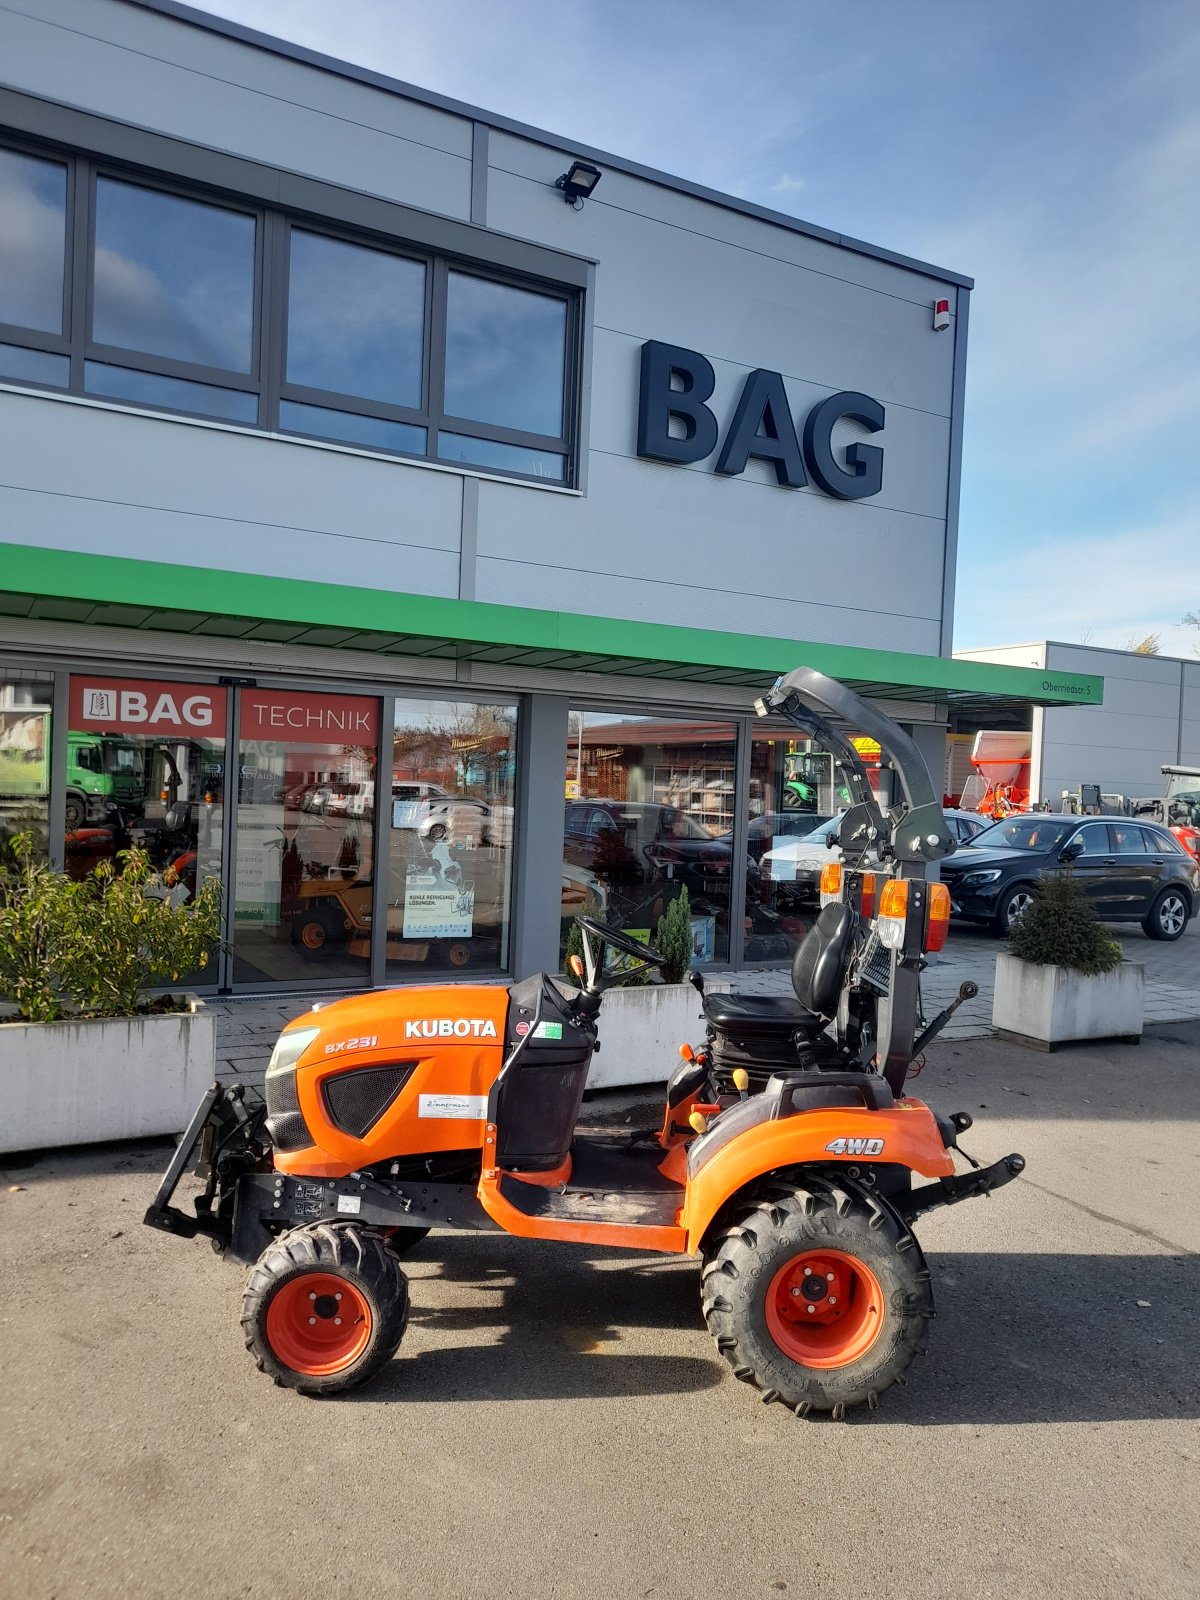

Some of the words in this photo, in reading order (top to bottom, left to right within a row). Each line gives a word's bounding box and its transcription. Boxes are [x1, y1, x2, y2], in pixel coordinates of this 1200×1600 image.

[636, 338, 886, 501] BAG
[1042, 680, 1085, 695] Oberriedstr.
[1086, 685, 1092, 695] 5
[120, 690, 213, 727] BAG
[253, 704, 370, 731] TECHNIK
[405, 1019, 497, 1038] KUBOTA
[825, 1137, 885, 1155] 4WD
